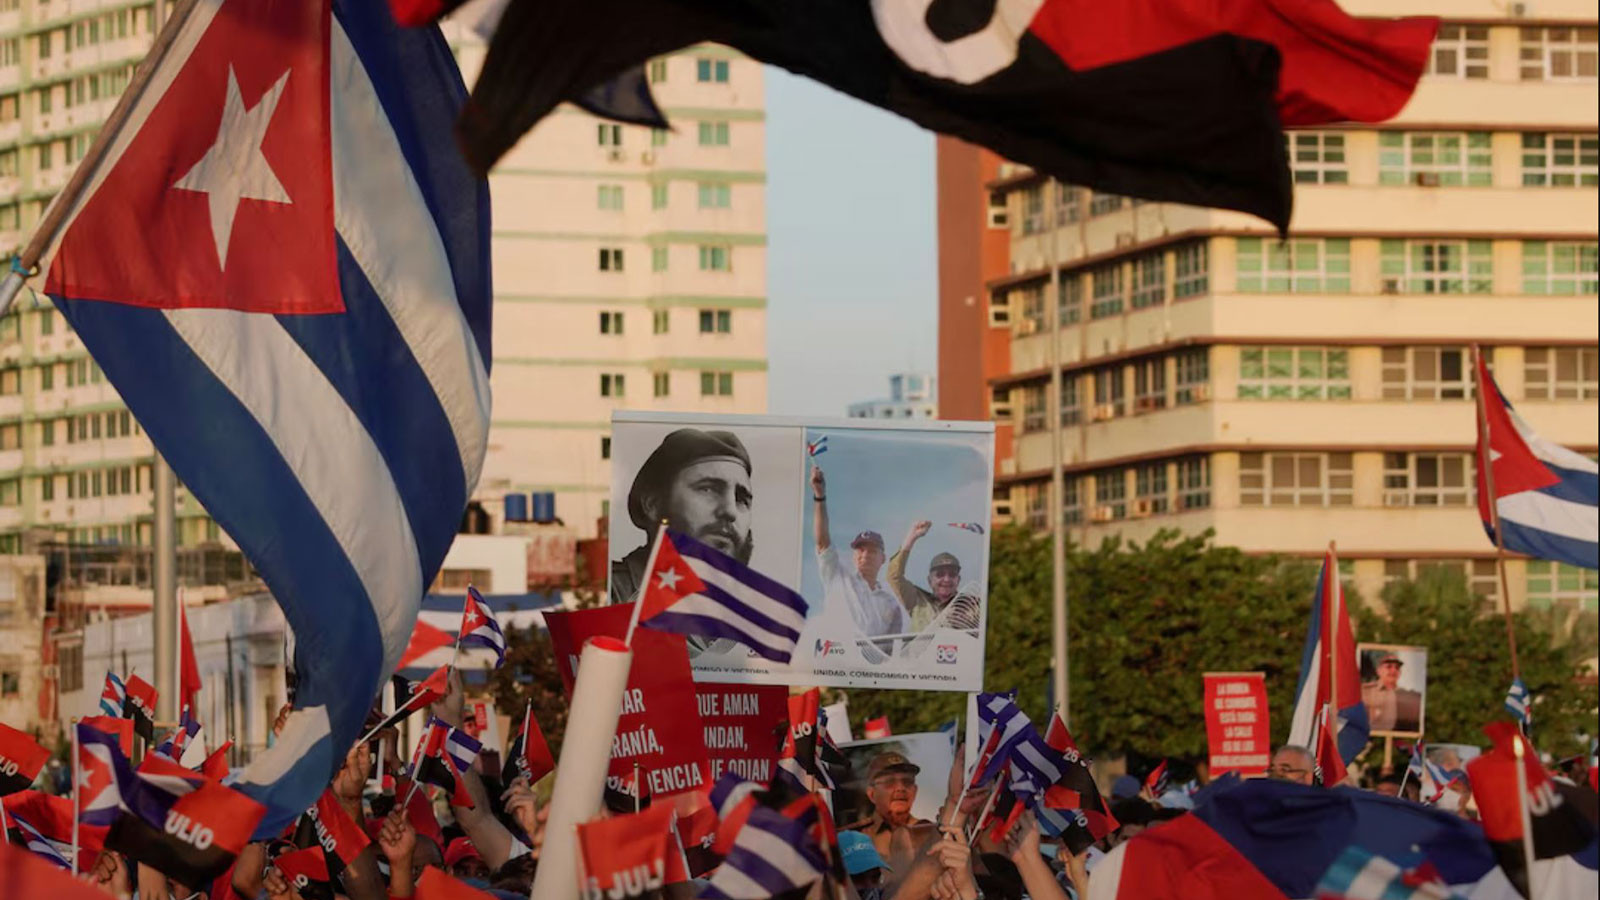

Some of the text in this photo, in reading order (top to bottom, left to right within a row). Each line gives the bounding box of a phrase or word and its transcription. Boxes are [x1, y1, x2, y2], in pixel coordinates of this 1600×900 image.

[620, 687, 646, 715] AR
[723, 693, 759, 716] AMAN
[610, 723, 664, 759] RANÍA,
[1063, 747, 1079, 763] 26
[728, 758, 769, 781] ODIAN
